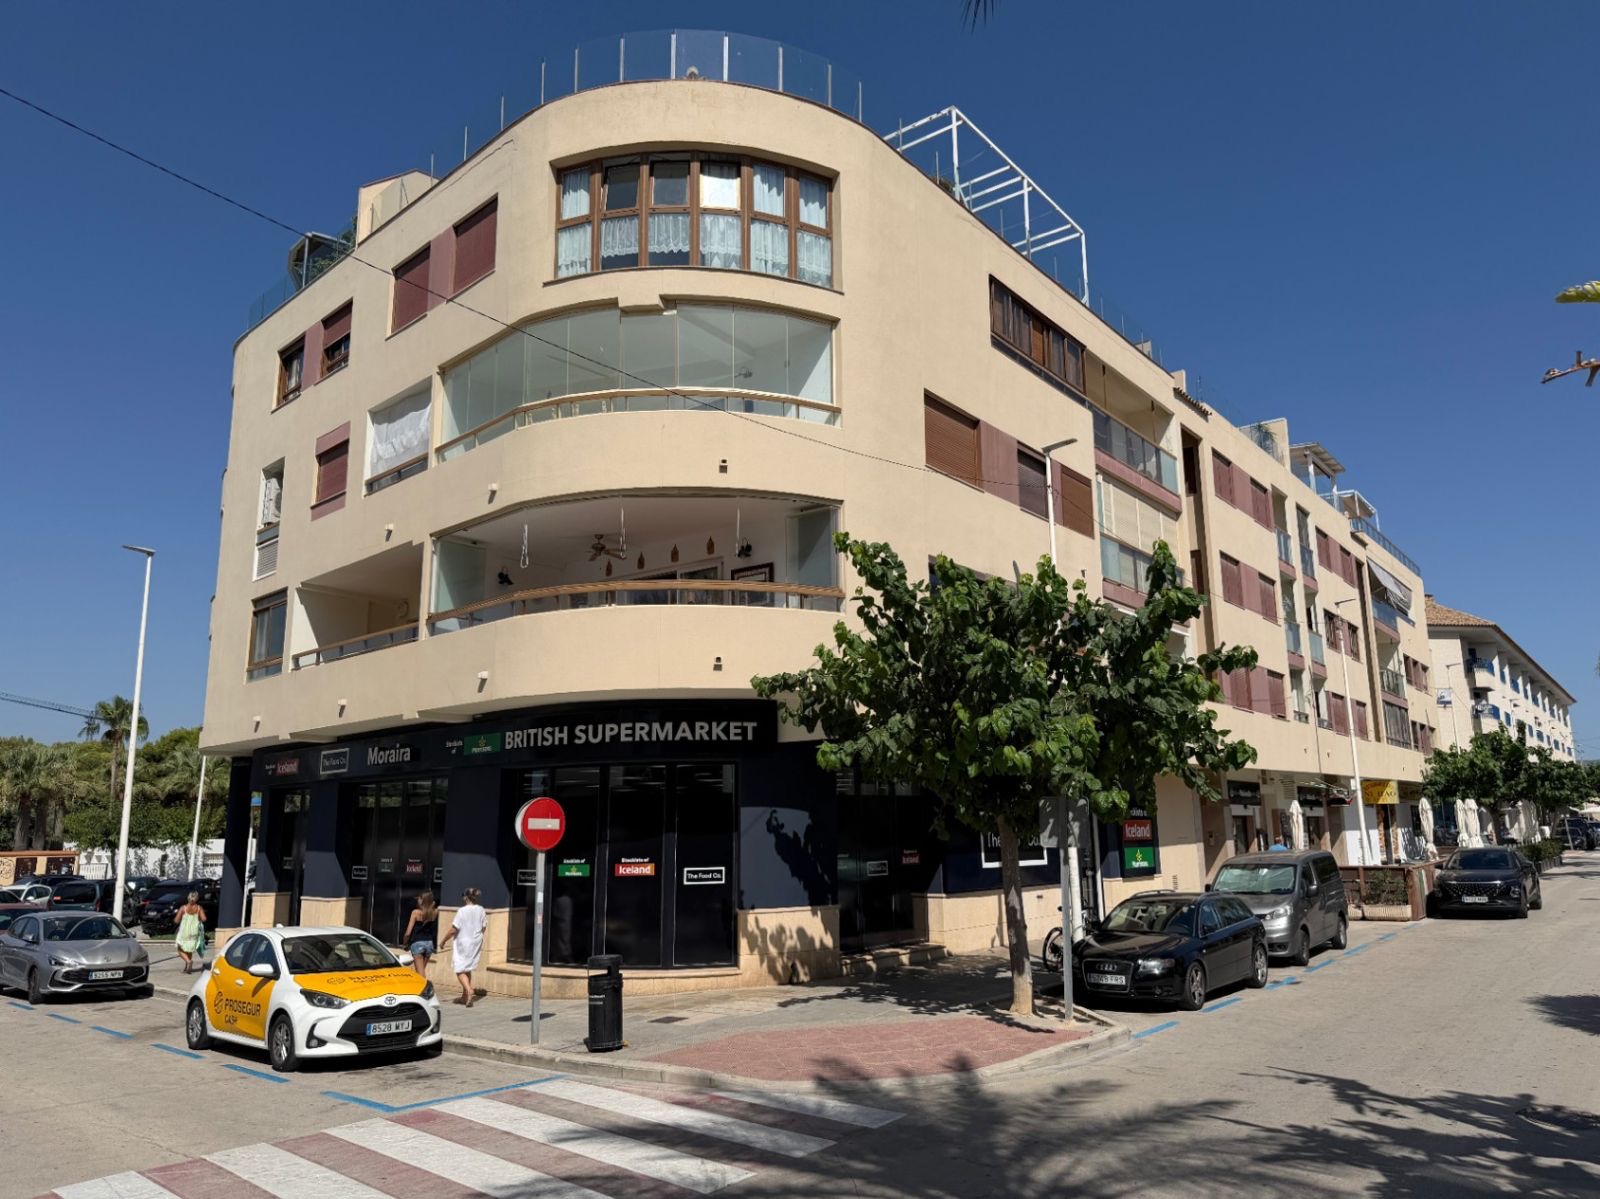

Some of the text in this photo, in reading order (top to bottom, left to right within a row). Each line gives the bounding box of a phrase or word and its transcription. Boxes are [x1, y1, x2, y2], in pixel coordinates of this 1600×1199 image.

[505, 721, 758, 750] BRITISH SUPERMARKET
[367, 743, 411, 766] Moraira
[1125, 823, 1150, 838] Iceland
[619, 865, 651, 875] Iceland
[225, 998, 261, 1017] PROSEGUR
